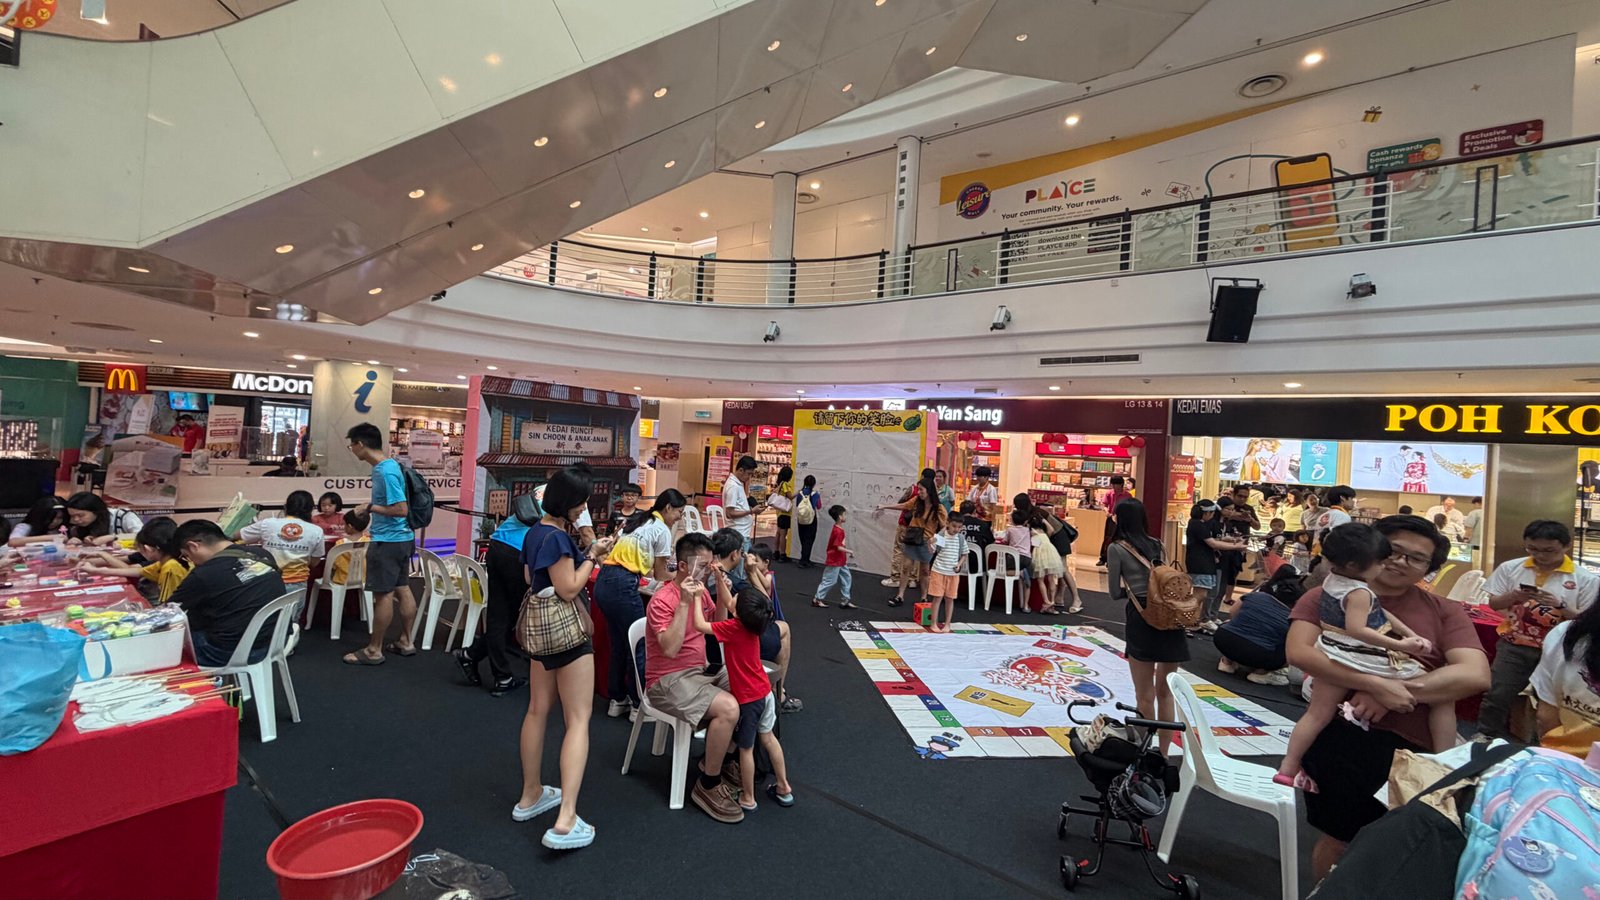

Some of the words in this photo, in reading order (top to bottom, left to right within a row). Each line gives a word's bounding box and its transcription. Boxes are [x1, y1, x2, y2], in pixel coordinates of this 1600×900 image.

[1465, 129, 1507, 140] Exclusive
[1464, 135, 1512, 147] Promotion
[1391, 144, 1423, 154] rewards
[1472, 144, 1498, 152] Deals
[1370, 154, 1404, 163] bonanza
[1025, 178, 1096, 204] PLAYCE
[1020, 205, 1063, 218] community.
[1066, 201, 1084, 210] Your
[1086, 195, 1122, 206] rewards.
[1038, 234, 1072, 244] download
[1037, 243, 1063, 251] PLAYCE
[232, 372, 314, 394] McDon
[724, 401, 740, 409] KEDAI
[1125, 400, 1136, 408] LG
[1137, 400, 1146, 408] 13
[1155, 400, 1163, 408] 14
[1177, 400, 1200, 414] KEDAI
[1200, 400, 1222, 414] EMAS
[937, 405, 962, 420] Yan
[964, 405, 1003, 426] Sang
[1384, 404, 1503, 433] POH
[1524, 404, 1600, 436] KO
[546, 425, 568, 433] KEDAI
[570, 426, 594, 435] RUNCIT
[542, 433, 566, 441] CHOON
[574, 435, 608, 443] ANAK-ANAK
[324, 479, 373, 489] CUSTO
[428, 478, 462, 488] RVICE
